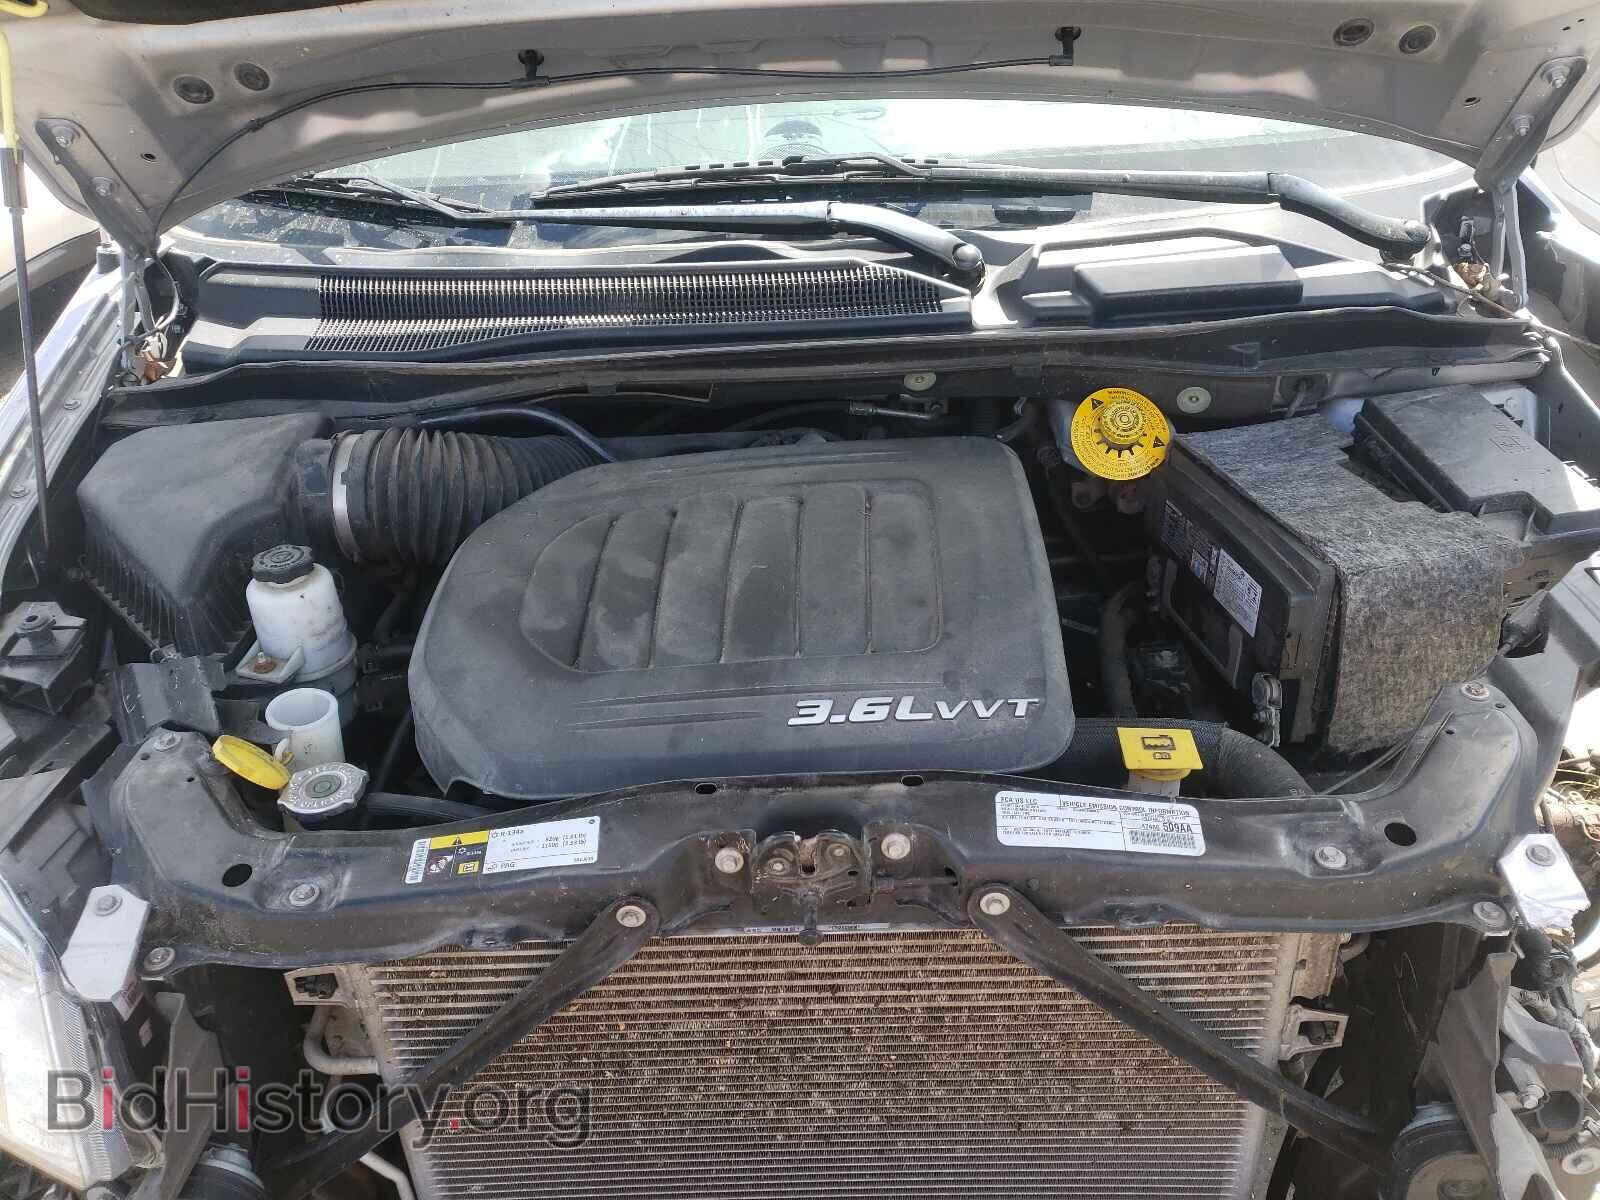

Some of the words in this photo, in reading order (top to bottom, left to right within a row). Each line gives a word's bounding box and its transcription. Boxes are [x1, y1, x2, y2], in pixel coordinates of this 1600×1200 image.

[787, 695, 933, 727] 3.6L
[934, 698, 1041, 720] VVT
[1088, 802, 1117, 810] EMISSION
[1119, 805, 1146, 813] CONTROL
[1148, 807, 1190, 816] INFORMATION
[1162, 822, 1193, 833] 509AA
